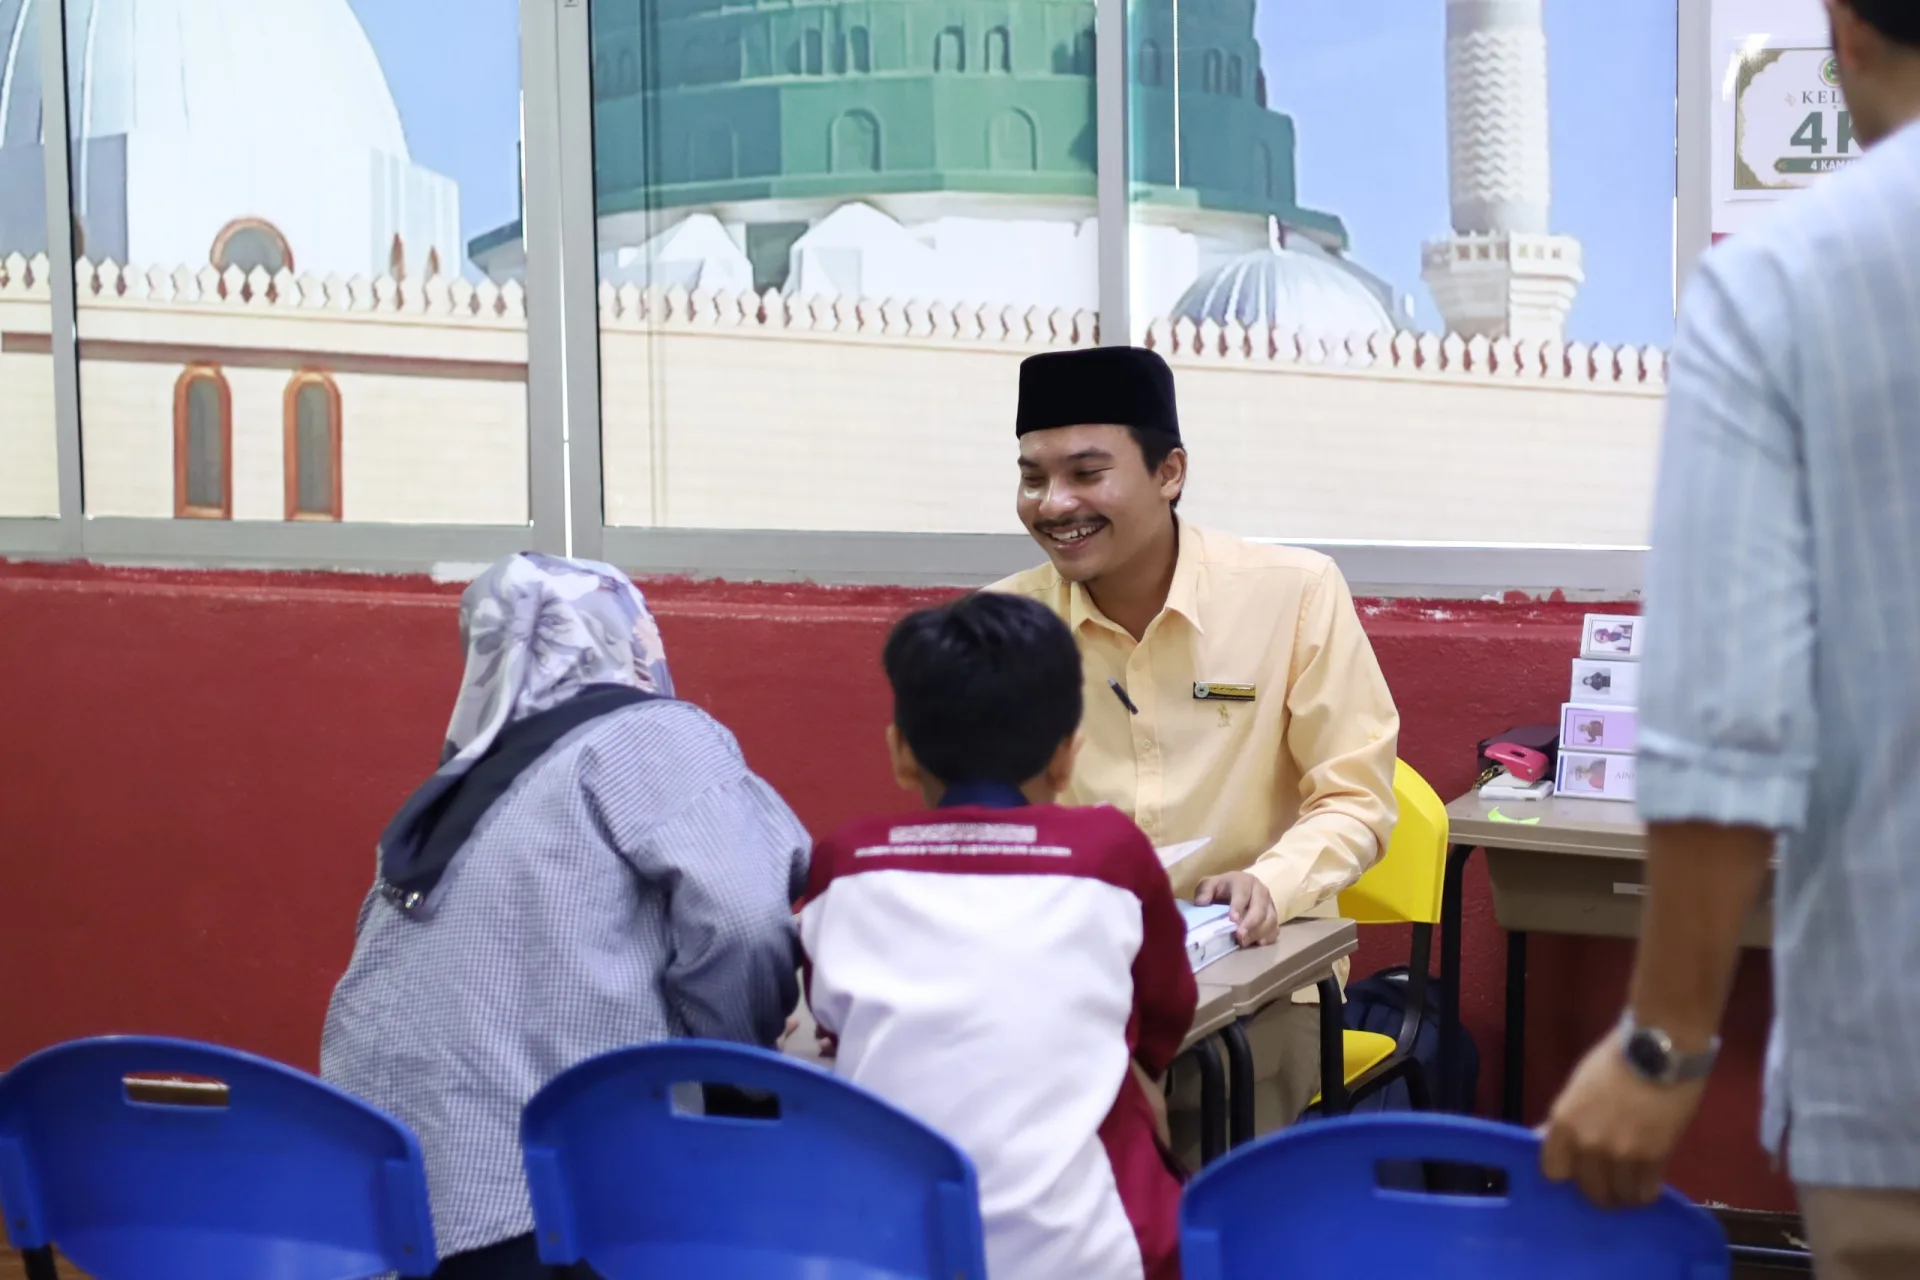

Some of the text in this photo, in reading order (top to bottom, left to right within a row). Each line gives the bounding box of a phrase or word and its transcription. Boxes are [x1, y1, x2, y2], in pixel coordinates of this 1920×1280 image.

[1802, 90, 1842, 104] KEL
[1810, 160, 1854, 171] 4 KAM
